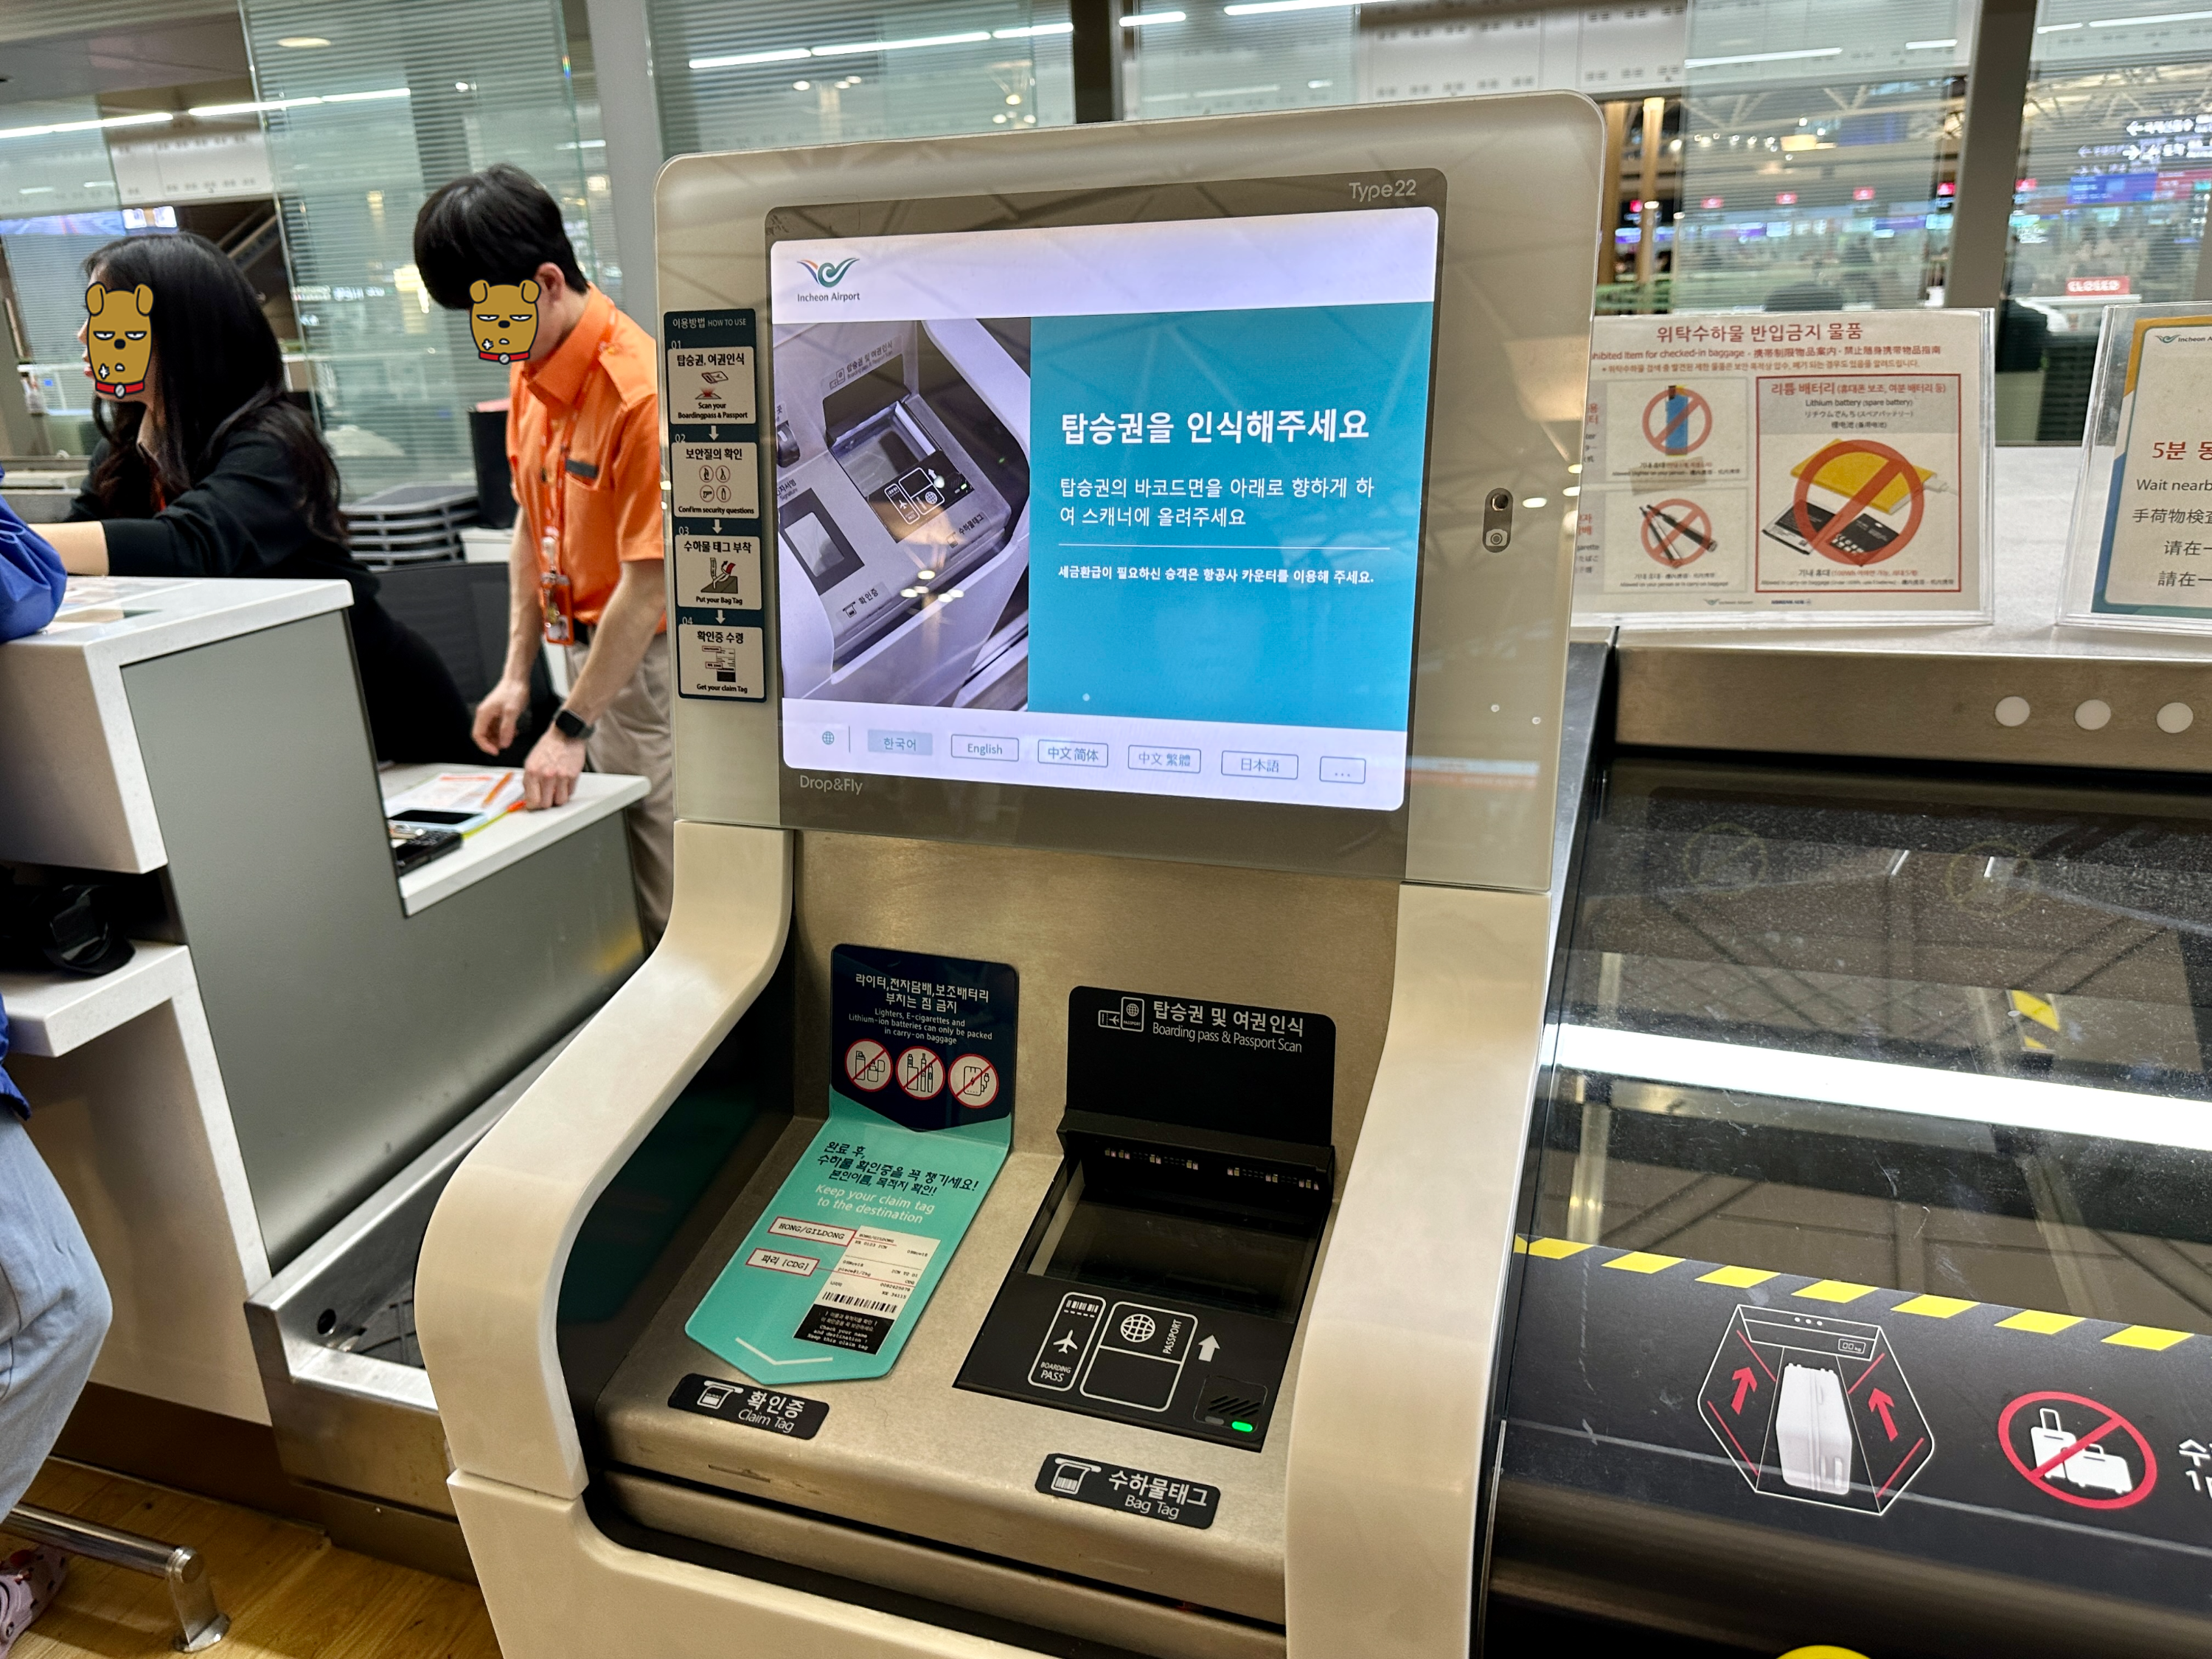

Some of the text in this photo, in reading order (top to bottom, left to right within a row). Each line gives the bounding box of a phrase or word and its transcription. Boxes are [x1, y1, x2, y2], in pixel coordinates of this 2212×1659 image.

[1348, 178, 1416, 202] Type22
[2067, 279, 2121, 292] CLOSED
[797, 292, 860, 302] Incheon Airport
[672, 317, 706, 329] 이용방법
[725, 319, 733, 327] TO
[734, 318, 746, 326] USE
[1657, 322, 1863, 343] 위탁수하물 반입금지 물품
[671, 341, 681, 349] 01
[677, 352, 745, 366] 탑승권, 여권인식
[1646, 350, 1658, 358] for
[1660, 349, 1706, 358] checked-in
[1708, 349, 1745, 358] baggage
[1771, 383, 1795, 395] 리튬
[1799, 382, 1834, 395] 배터리
[1907, 383, 1932, 394] 배터리
[712, 403, 726, 411] your
[723, 411, 748, 420] Passport
[1061, 408, 1370, 445] 탑승권을 인식해주세요
[675, 434, 686, 442] 02
[686, 448, 742, 460] 보안질의 확인
[2152, 441, 2187, 460] 5분
[1060, 476, 1375, 499] 탑승권의 바코드면을 아래로 향하게 하
[2137, 479, 2168, 491] Wait
[702, 507, 726, 515] security
[1060, 506, 1246, 528] 여 스캐너에 올려주세요
[678, 526, 689, 535] 03
[684, 541, 711, 553] 수하물
[733, 542, 752, 554] 부착
[1058, 565, 1374, 584] 세금환급이 필요하신 승객은 항공사 카운터를 이용해 주세요.
[682, 616, 693, 625] 04
[698, 630, 743, 644] 확인증 수령
[883, 737, 917, 751] 한국어
[967, 743, 1003, 757] English
[1048, 746, 1099, 762] 中文 简体
[1138, 752, 1163, 765] 中文
[1240, 757, 1280, 773] 日本語
[800, 774, 863, 795] Drop&Fly
[886, 992, 957, 1015] 부치는 짐 금지
[874, 1008, 966, 1027] Lighters, E-cigarettes and
[1153, 1001, 1304, 1038] 탑승권 및 여권인식
[849, 1013, 992, 1040] Lithium-ion batteries can only be packed
[884, 1026, 957, 1046] in carry-on baggage
[1152, 1022, 1303, 1053] Boarding pass & Passport Scan
[824, 1141, 866, 1159] 완료 후,
[817, 1154, 979, 1192] 수하물 확인증을 꼭 챙기세요!
[829, 1169, 938, 1196] 본인이름, 목적지 확인!
[815, 1184, 935, 1215] Keep your claim tag
[817, 1196, 923, 1224] to the destination
[779, 1222, 845, 1239] HONG/GILDONG
[761, 1255, 810, 1271] 파리 [CDG]
[1162, 1318, 1183, 1354] PASSPORT
[1040, 1361, 1072, 1374] BOARDING
[1040, 1370, 1065, 1382] PASS
[747, 1390, 805, 1419] 확인증
[738, 1408, 795, 1433] Claim Tag
[1108, 1470, 1208, 1507] 수하물태그
[1124, 1494, 1180, 1520] Bag Tag
